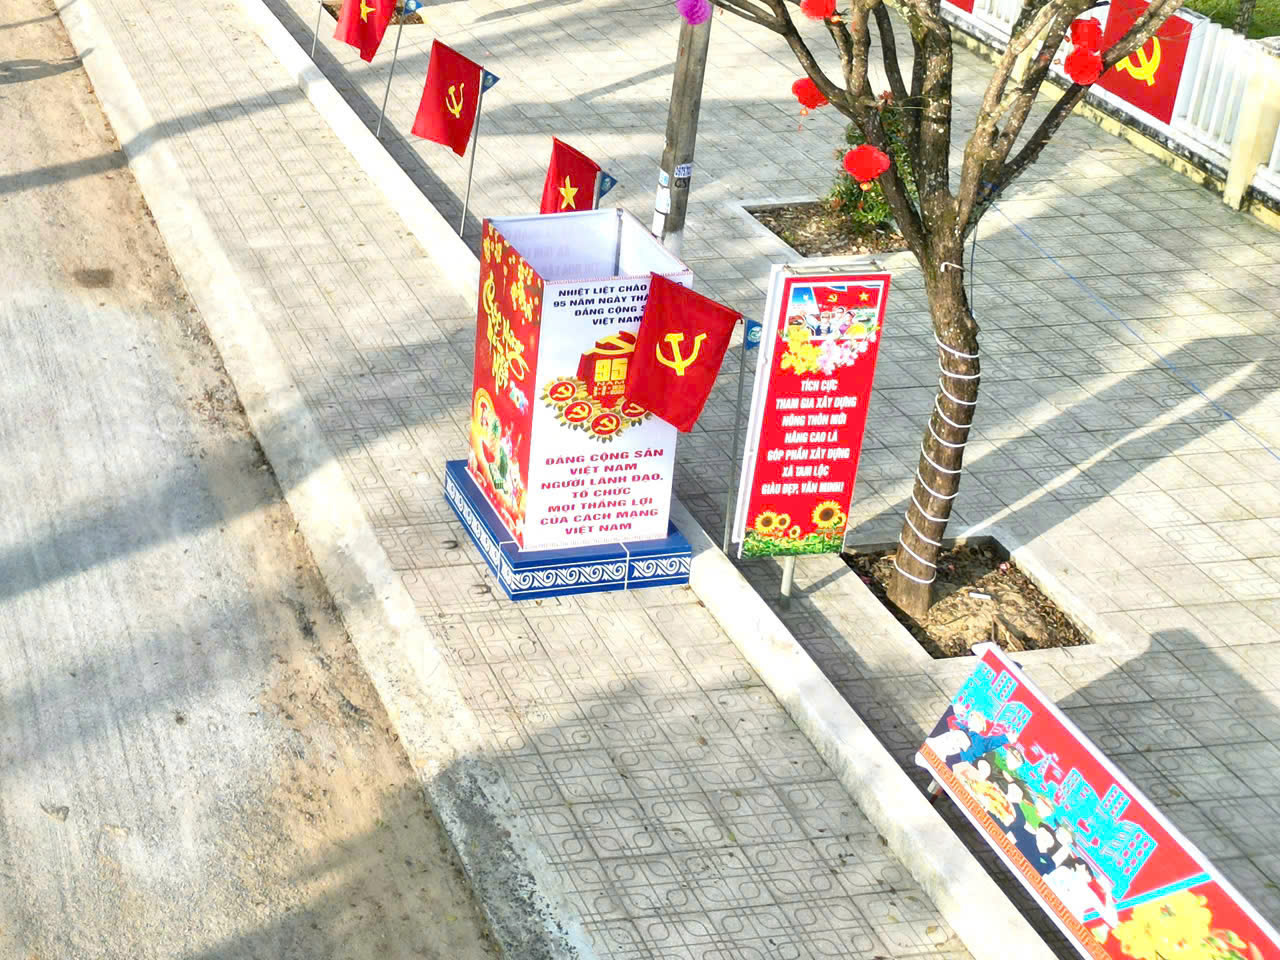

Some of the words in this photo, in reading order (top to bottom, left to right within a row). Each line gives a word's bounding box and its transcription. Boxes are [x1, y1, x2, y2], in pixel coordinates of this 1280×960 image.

[558, 287, 589, 297] NHIỆT
[593, 286, 615, 295] LIỆT
[570, 297, 595, 307] NĂM
[598, 294, 627, 304] NGÀY
[608, 305, 637, 315] CỘNG
[592, 317, 615, 326] VIỆT
[594, 357, 628, 382] 95
[801, 378, 820, 392] TÍCH
[775, 398, 799, 410] THAM
[800, 397, 815, 409] GIA
[809, 432, 826, 442] CAO
[590, 452, 629, 462] CỘNG
[570, 466, 599, 475] VIỆT
[604, 463, 638, 473] NAM
[795, 465, 813, 477] TAM
[565, 525, 594, 535] VIỆT
[599, 522, 632, 532] NAM
